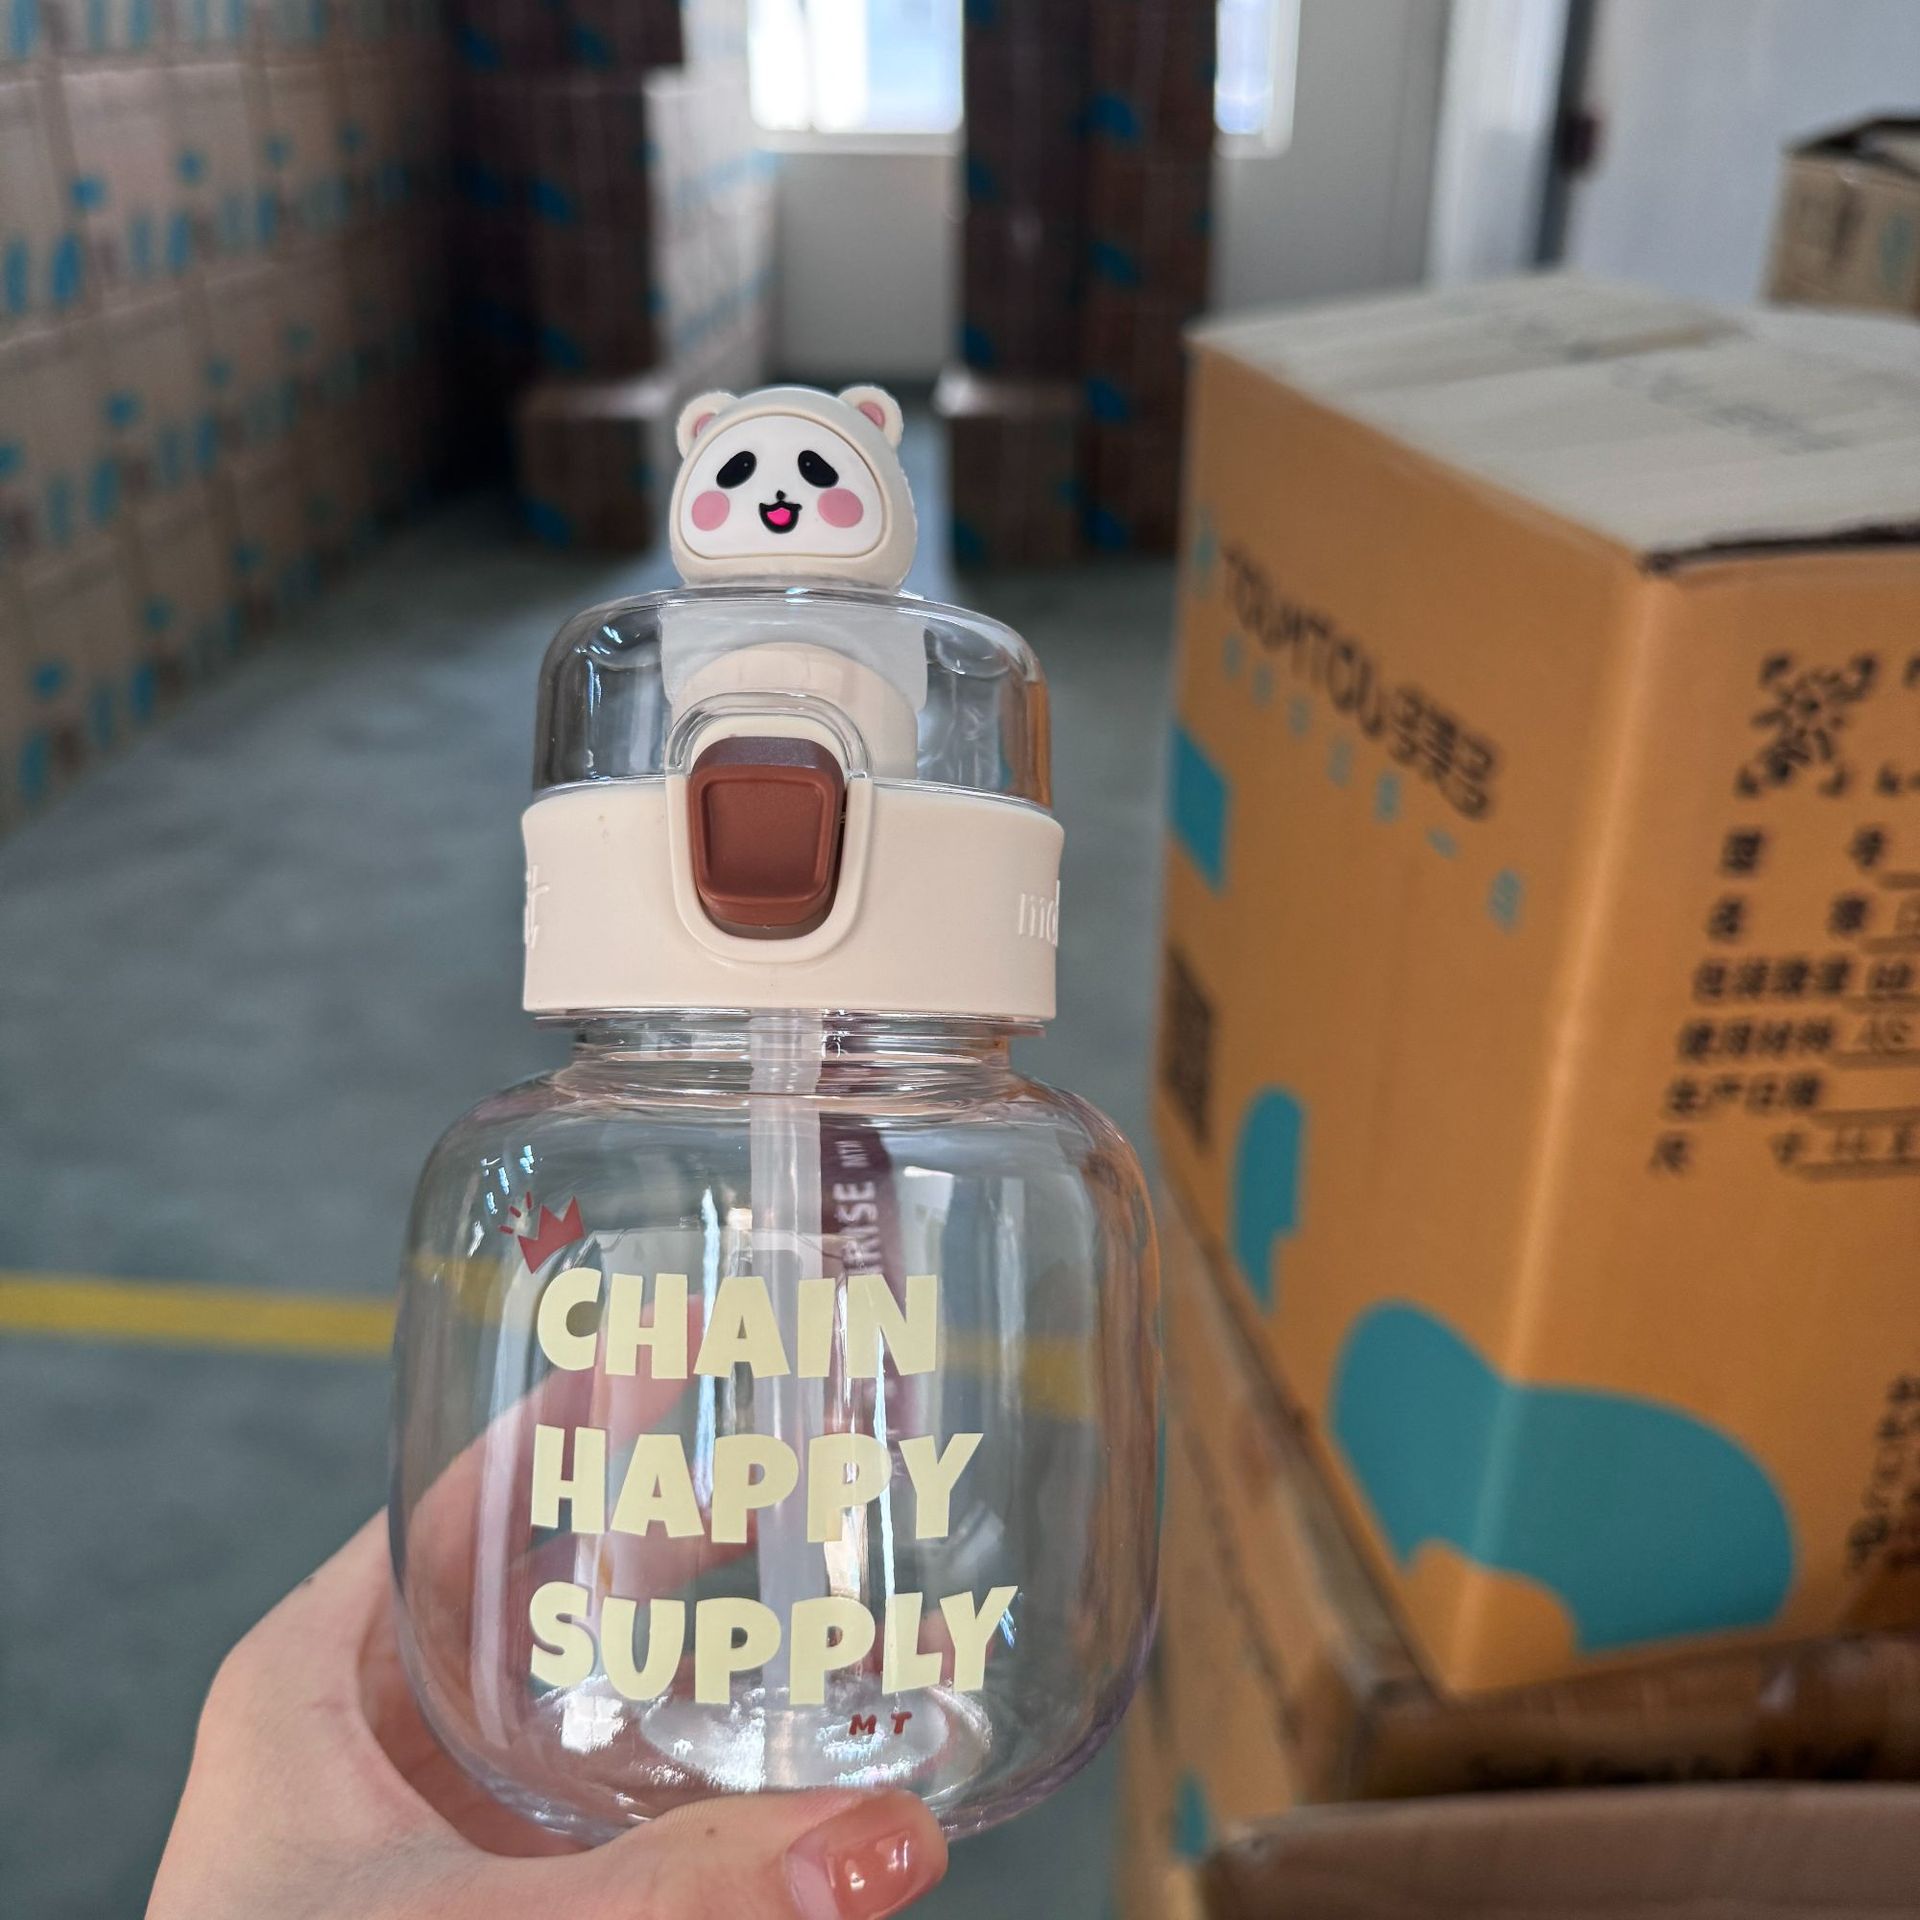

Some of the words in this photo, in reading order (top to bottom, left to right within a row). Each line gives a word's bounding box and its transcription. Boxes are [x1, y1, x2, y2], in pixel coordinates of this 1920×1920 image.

[536, 1267, 939, 1379] CHAIN
[531, 1424, 984, 1544] HAPPY
[529, 1581, 1019, 1706] SUPPLY
